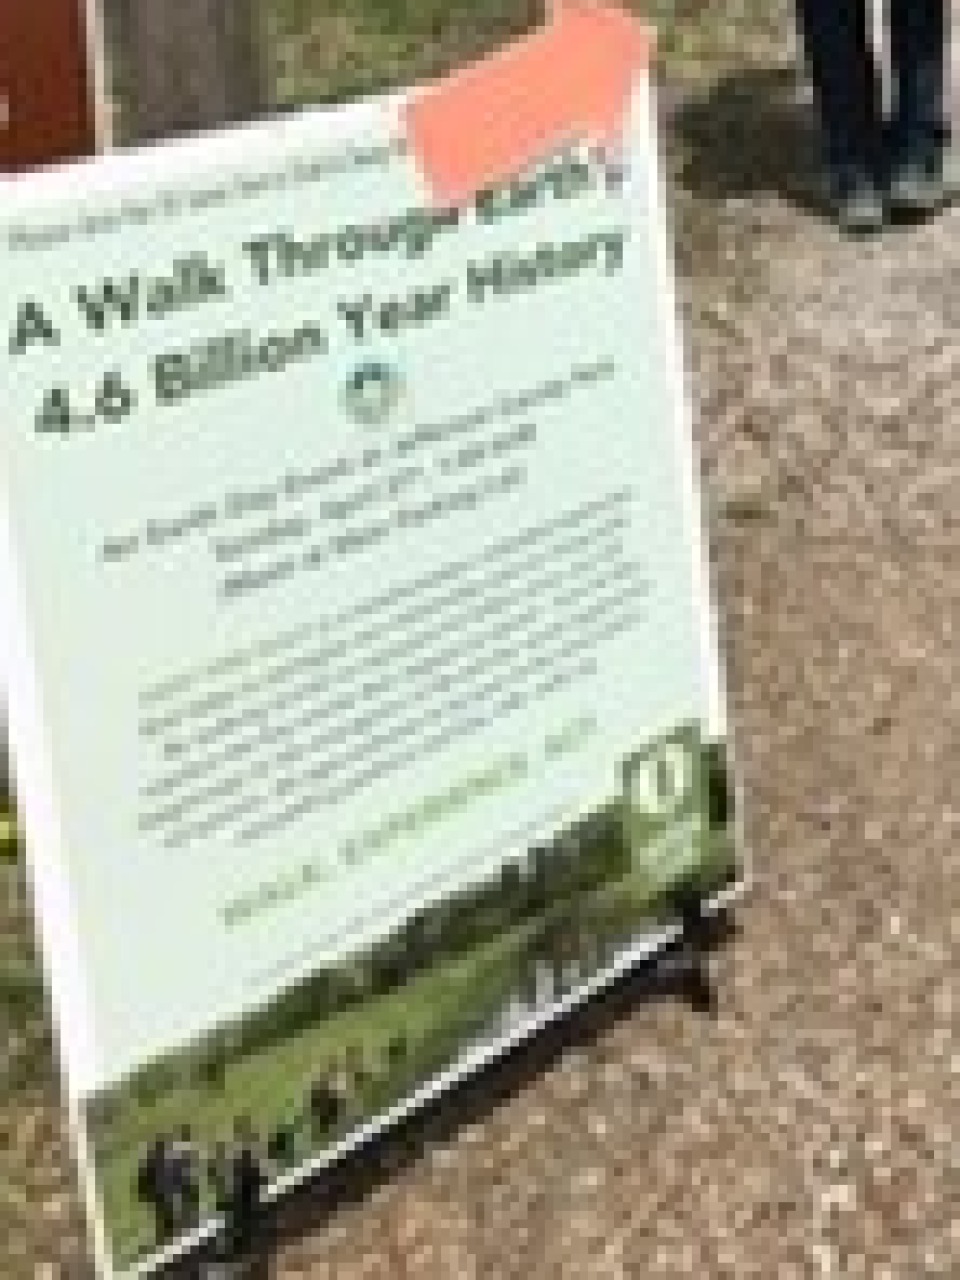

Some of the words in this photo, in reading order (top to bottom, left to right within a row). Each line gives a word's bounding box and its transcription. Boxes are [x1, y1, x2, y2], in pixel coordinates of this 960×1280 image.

[8, 298, 58, 356] A
[73, 250, 227, 334] Walk
[34, 372, 135, 436] 4.6
[151, 322, 326, 405] Billion
[336, 280, 454, 344] Year
[465, 230, 627, 303] History
